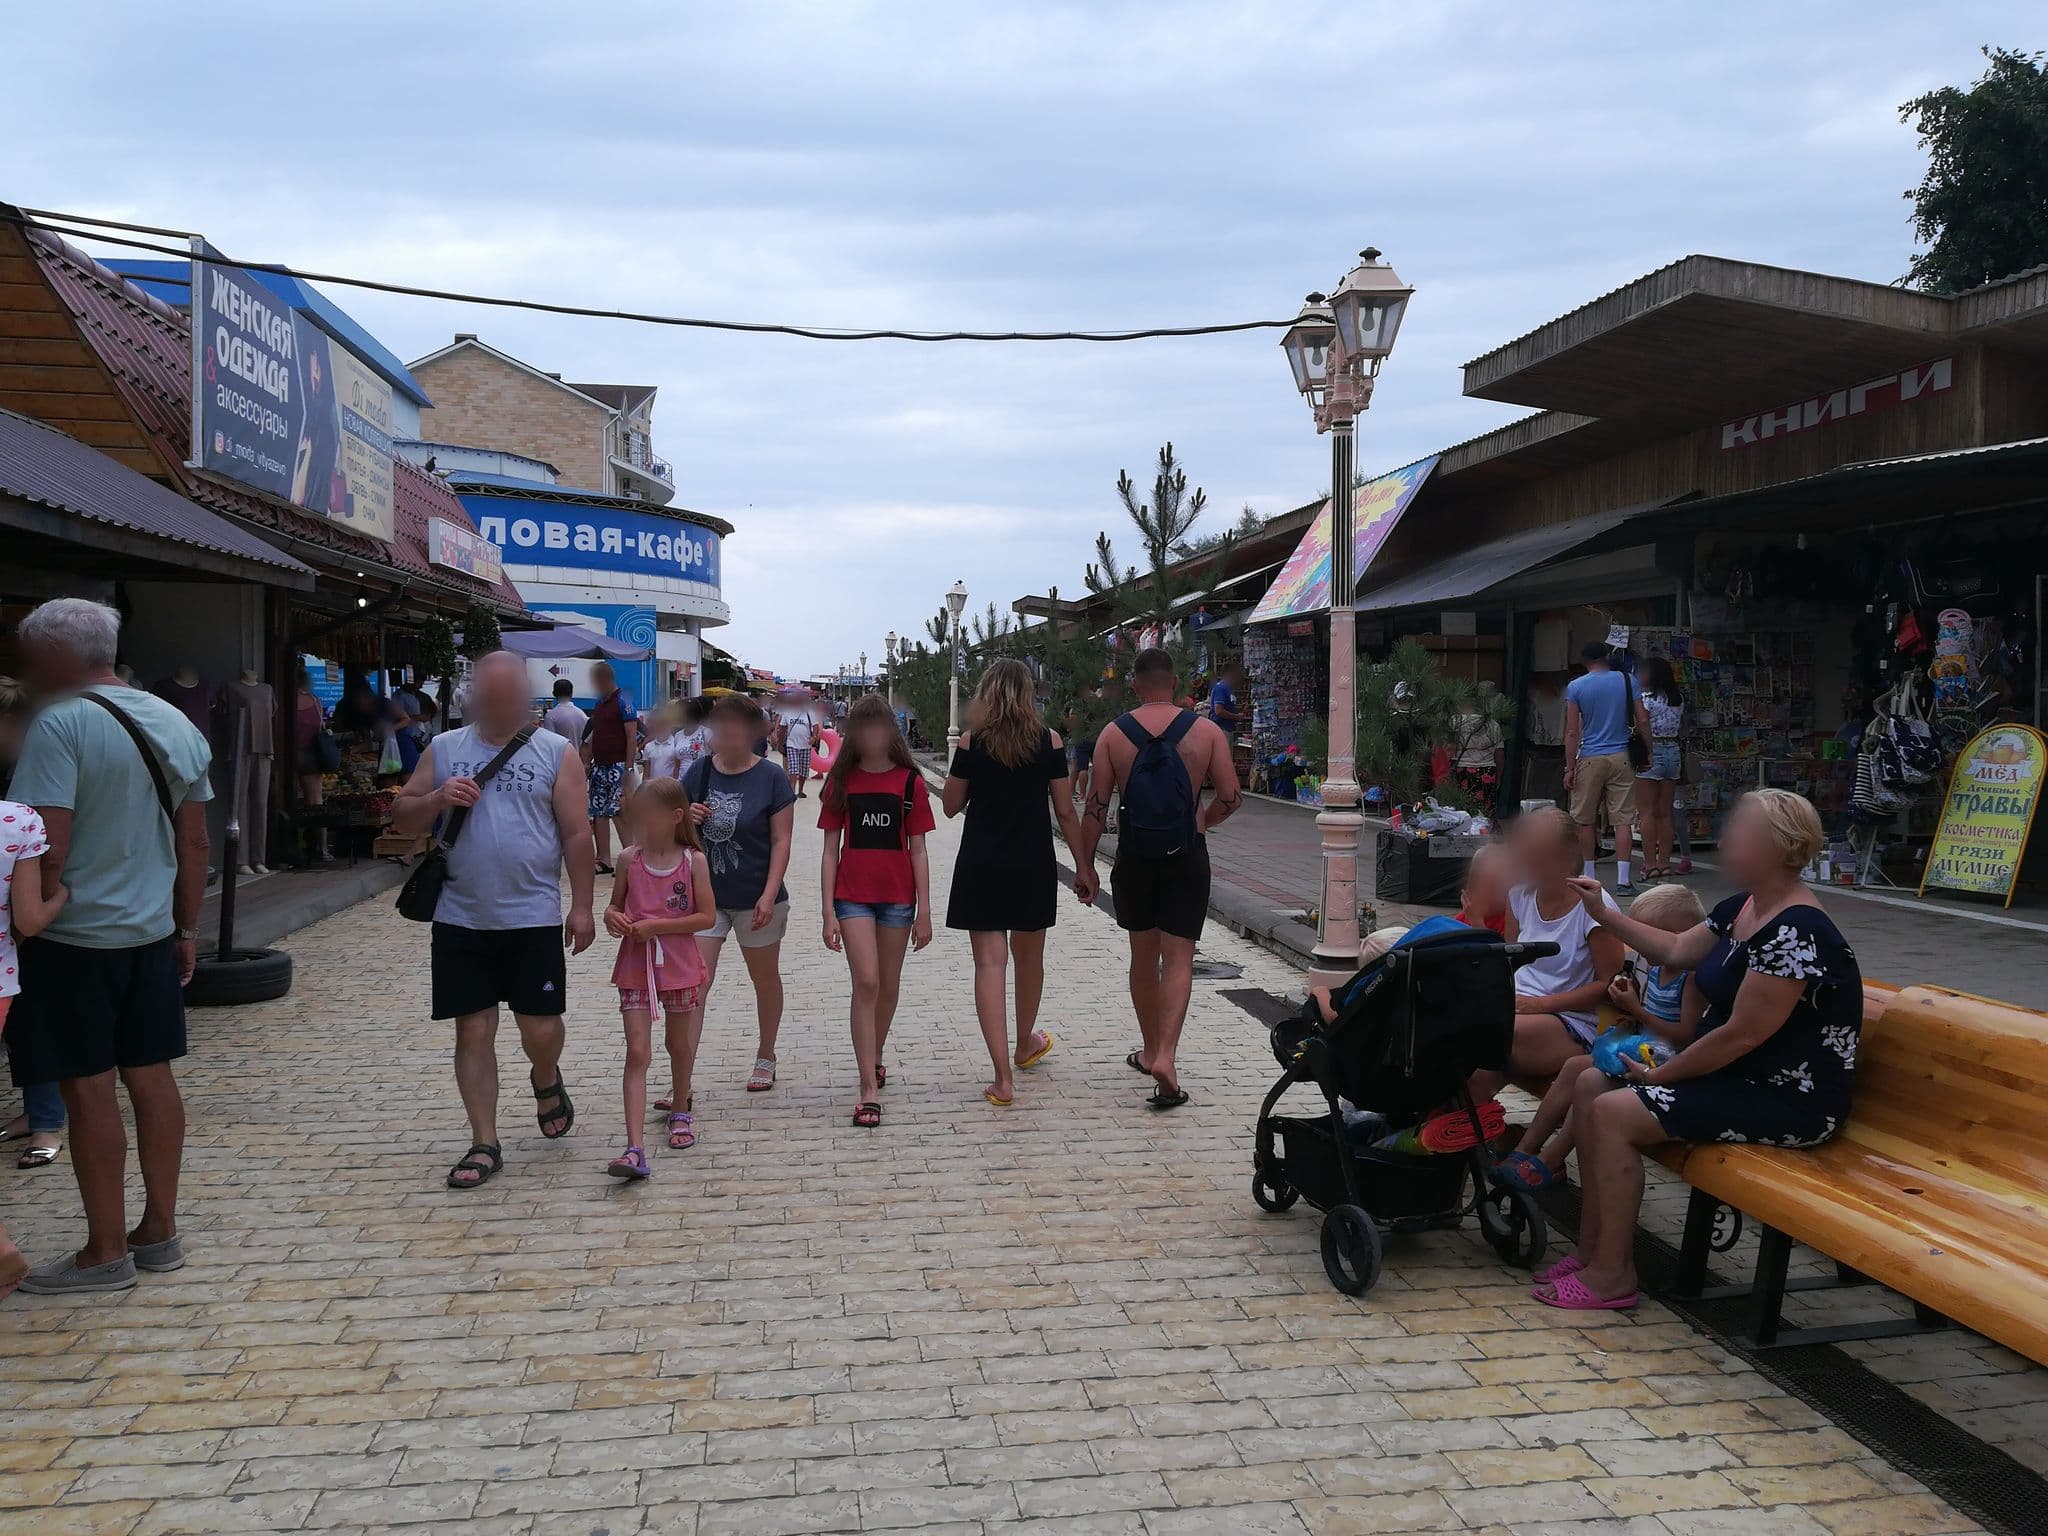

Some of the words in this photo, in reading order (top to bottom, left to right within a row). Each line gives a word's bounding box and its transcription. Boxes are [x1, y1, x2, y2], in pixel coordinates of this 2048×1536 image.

[211, 269, 292, 360] ЖЕНСКАЯ
[216, 326, 289, 403] ОДЕЖДА
[205, 346, 217, 383] &
[216, 383, 288, 440] аксессуары
[1721, 358, 1952, 450] КНИГИ
[1974, 765, 2018, 783] МЁД
[496, 783, 534, 793] BOSS
[1967, 784, 2021, 795] Лечебные
[862, 812, 891, 828] AND
[1944, 823, 2020, 841] КОСМЕТИКА
[1949, 844, 2005, 860] ГРЯЗИ
